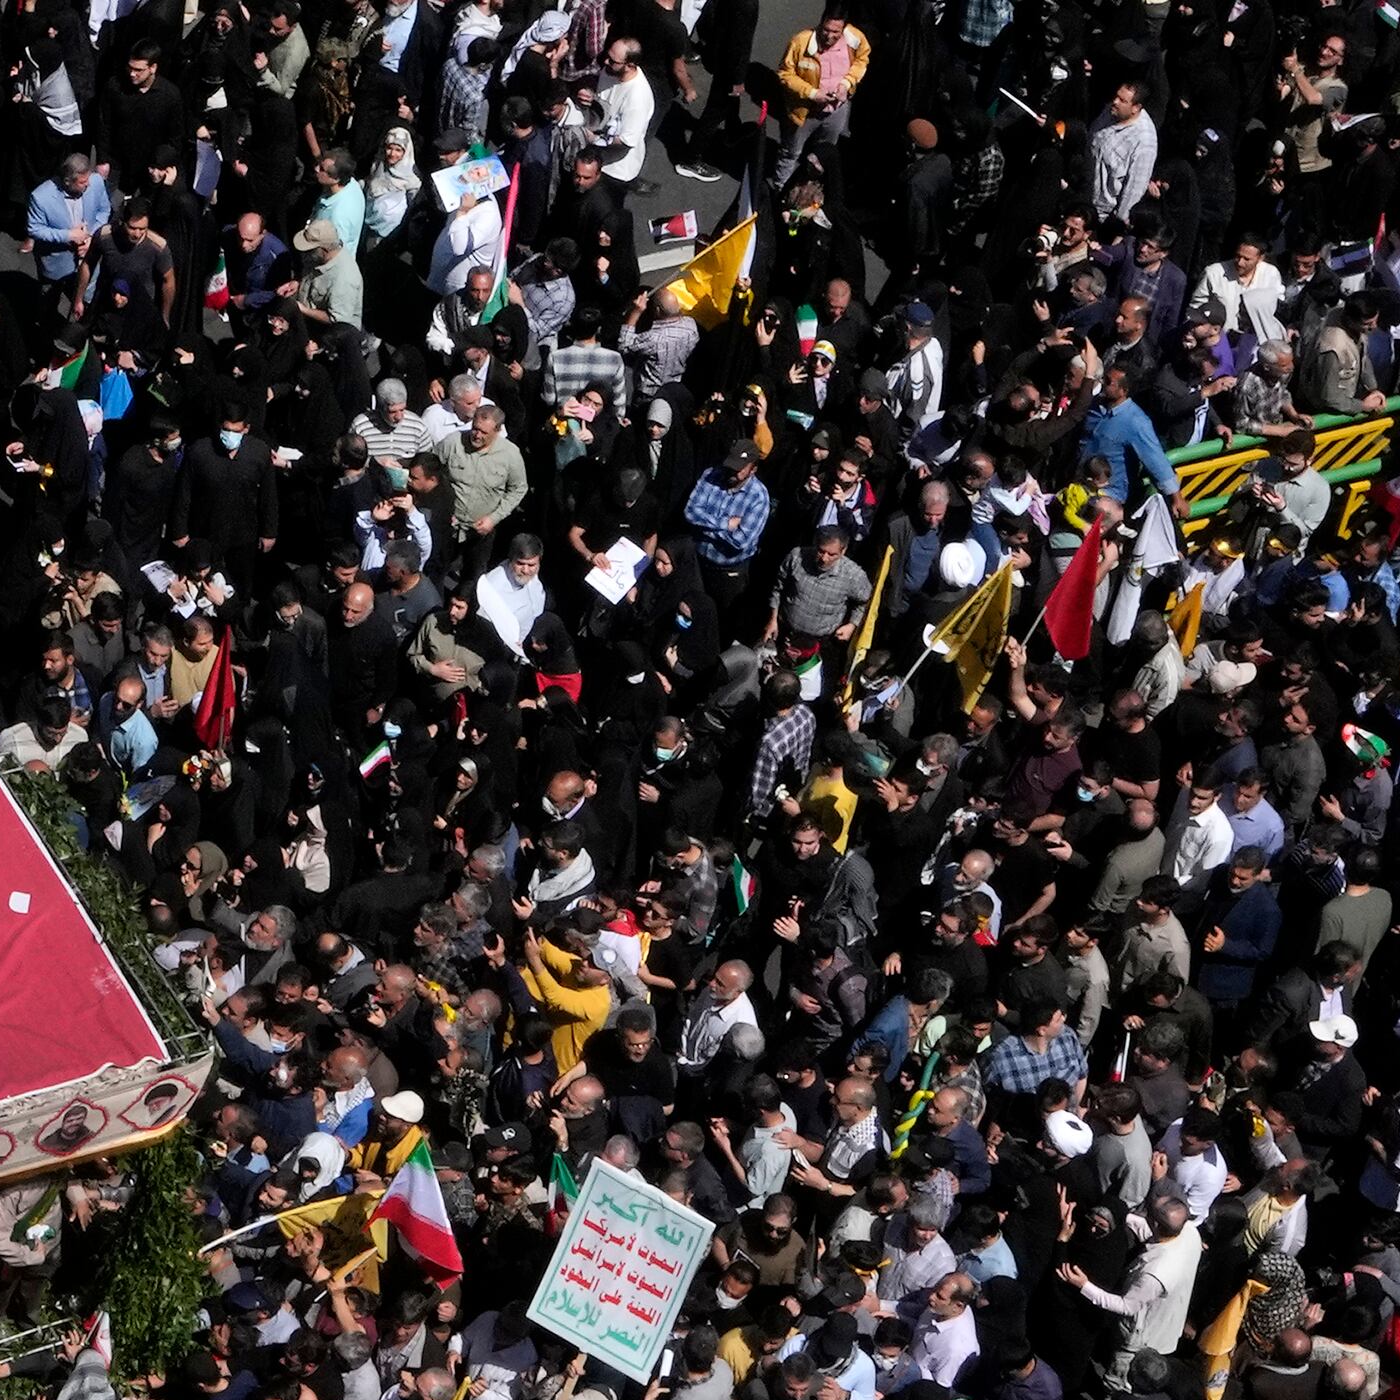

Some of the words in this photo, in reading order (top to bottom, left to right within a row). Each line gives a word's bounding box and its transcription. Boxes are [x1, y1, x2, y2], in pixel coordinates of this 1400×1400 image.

[637, 1244, 683, 1278] الموت
[560, 1263, 600, 1293] اليهود
[627, 1270, 673, 1302] الموت
[626, 1295, 662, 1327] اللعنة
[599, 1323, 651, 1354] النصر
